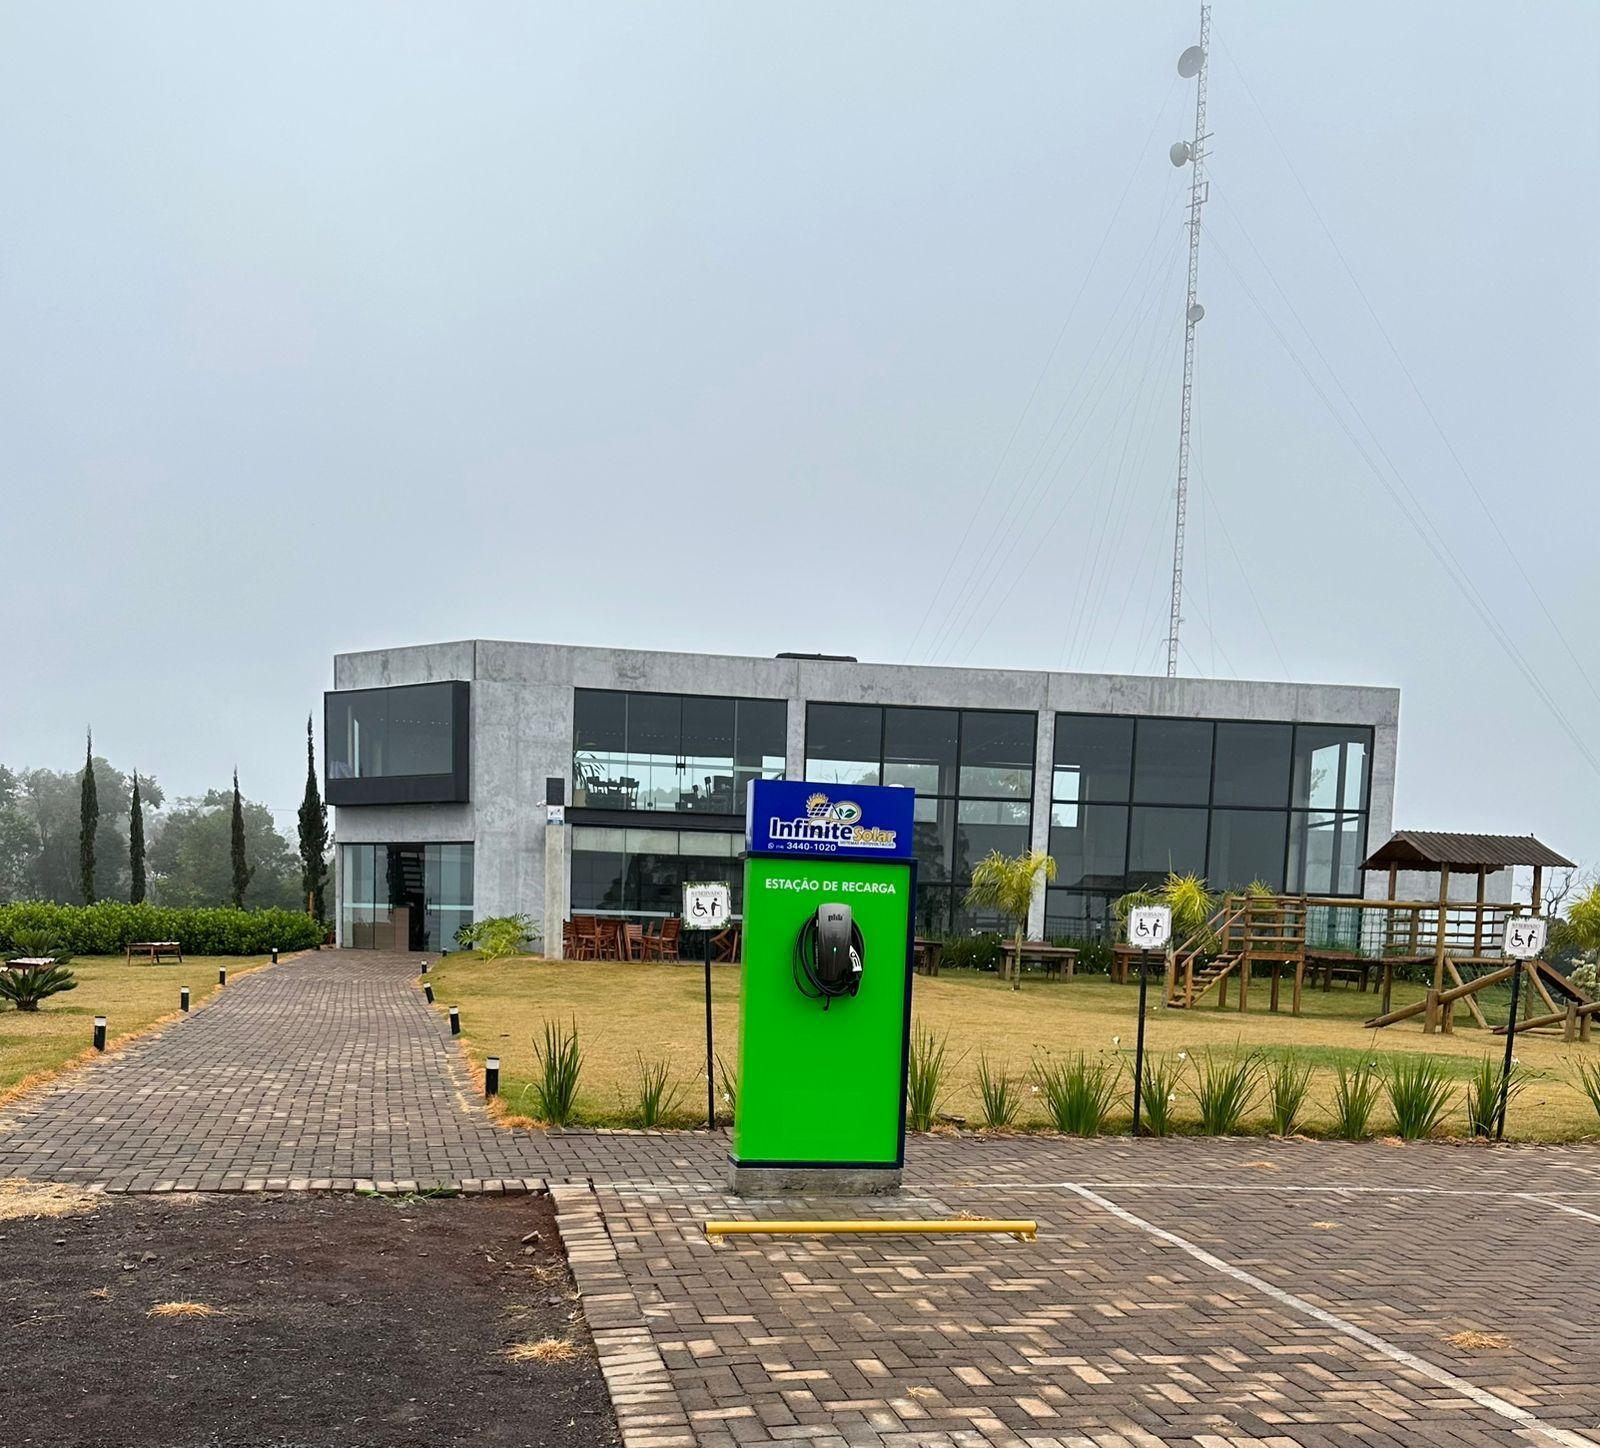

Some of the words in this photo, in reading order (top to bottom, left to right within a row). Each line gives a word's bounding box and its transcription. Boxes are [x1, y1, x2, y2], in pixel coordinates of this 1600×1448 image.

[769, 817, 853, 841] Infinite
[853, 826, 896, 842] Solar
[786, 841, 837, 852] 3440-1020
[765, 877, 819, 893] ESTAÇÃO
[823, 881, 838, 892] DE
[842, 881, 896, 894] RECARGA
